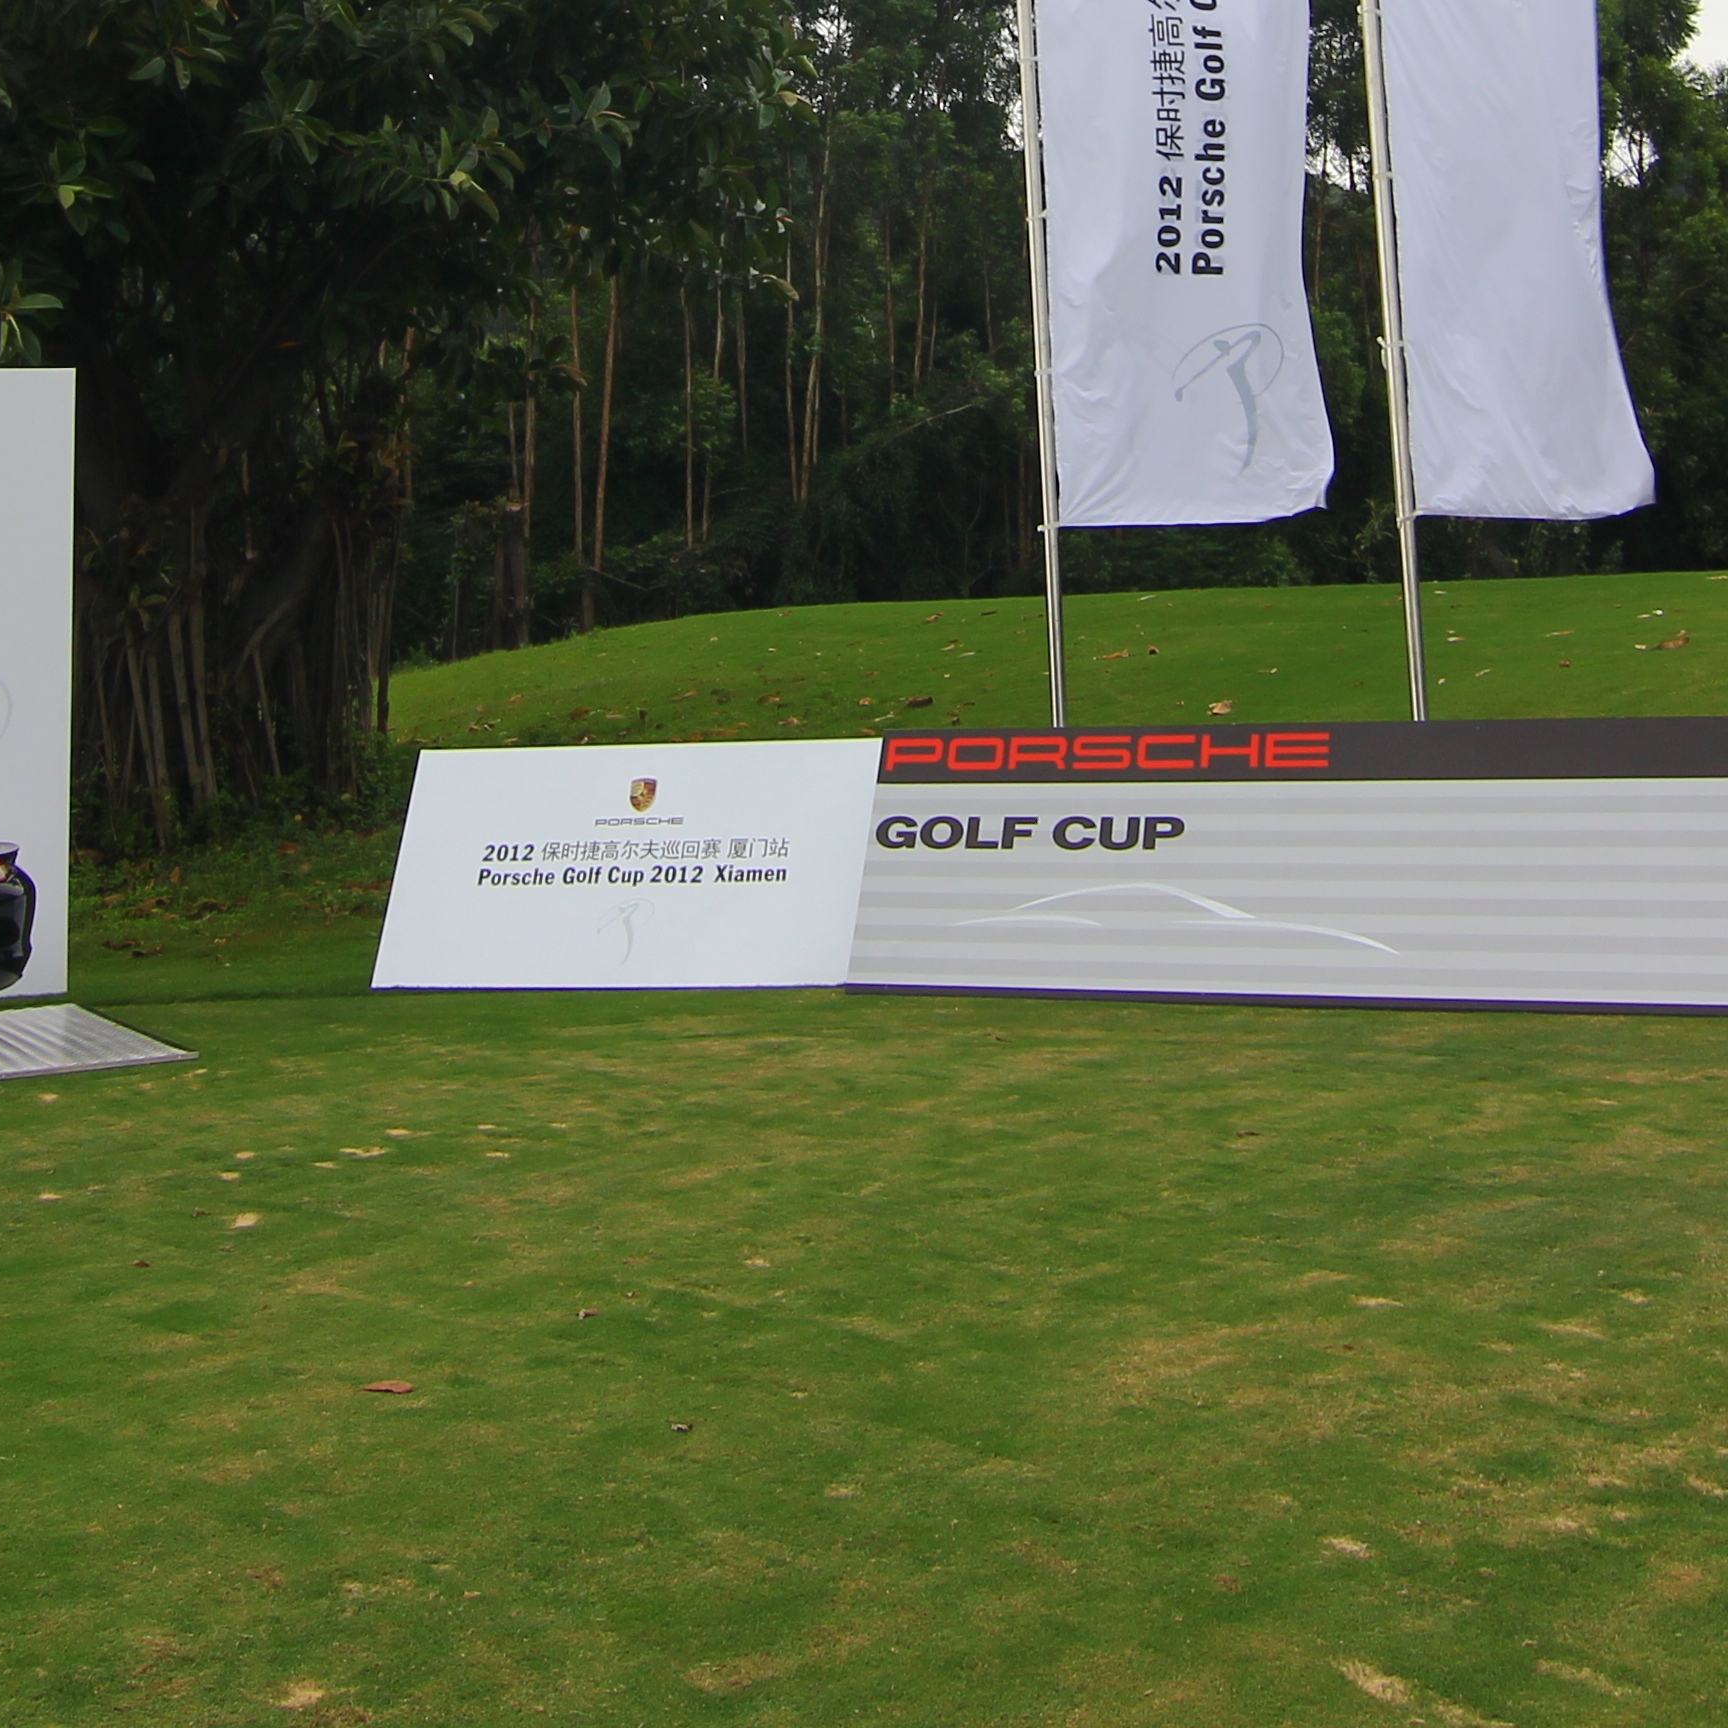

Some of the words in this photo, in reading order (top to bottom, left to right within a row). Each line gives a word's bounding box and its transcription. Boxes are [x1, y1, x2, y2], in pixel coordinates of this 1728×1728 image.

[1192, 24, 1227, 101] Golf
[1191, 118, 1226, 276] Porsche
[1155, 175, 1183, 275] 2012
[885, 733, 1330, 771] PORSCHE
[595, 817, 684, 826] PORSCHE
[875, 816, 1038, 849] GOLF
[1052, 816, 1185, 850] CUP
[483, 844, 534, 861] 2012
[541, 839, 721, 861] 保时捷高尔夫巡回赛
[727, 837, 790, 859] 厦门站
[478, 868, 555, 886] Porsche
[562, 866, 603, 884] Golf
[608, 866, 645, 886] Cup
[650, 865, 704, 883] 2012
[714, 864, 788, 882] Xiamen
